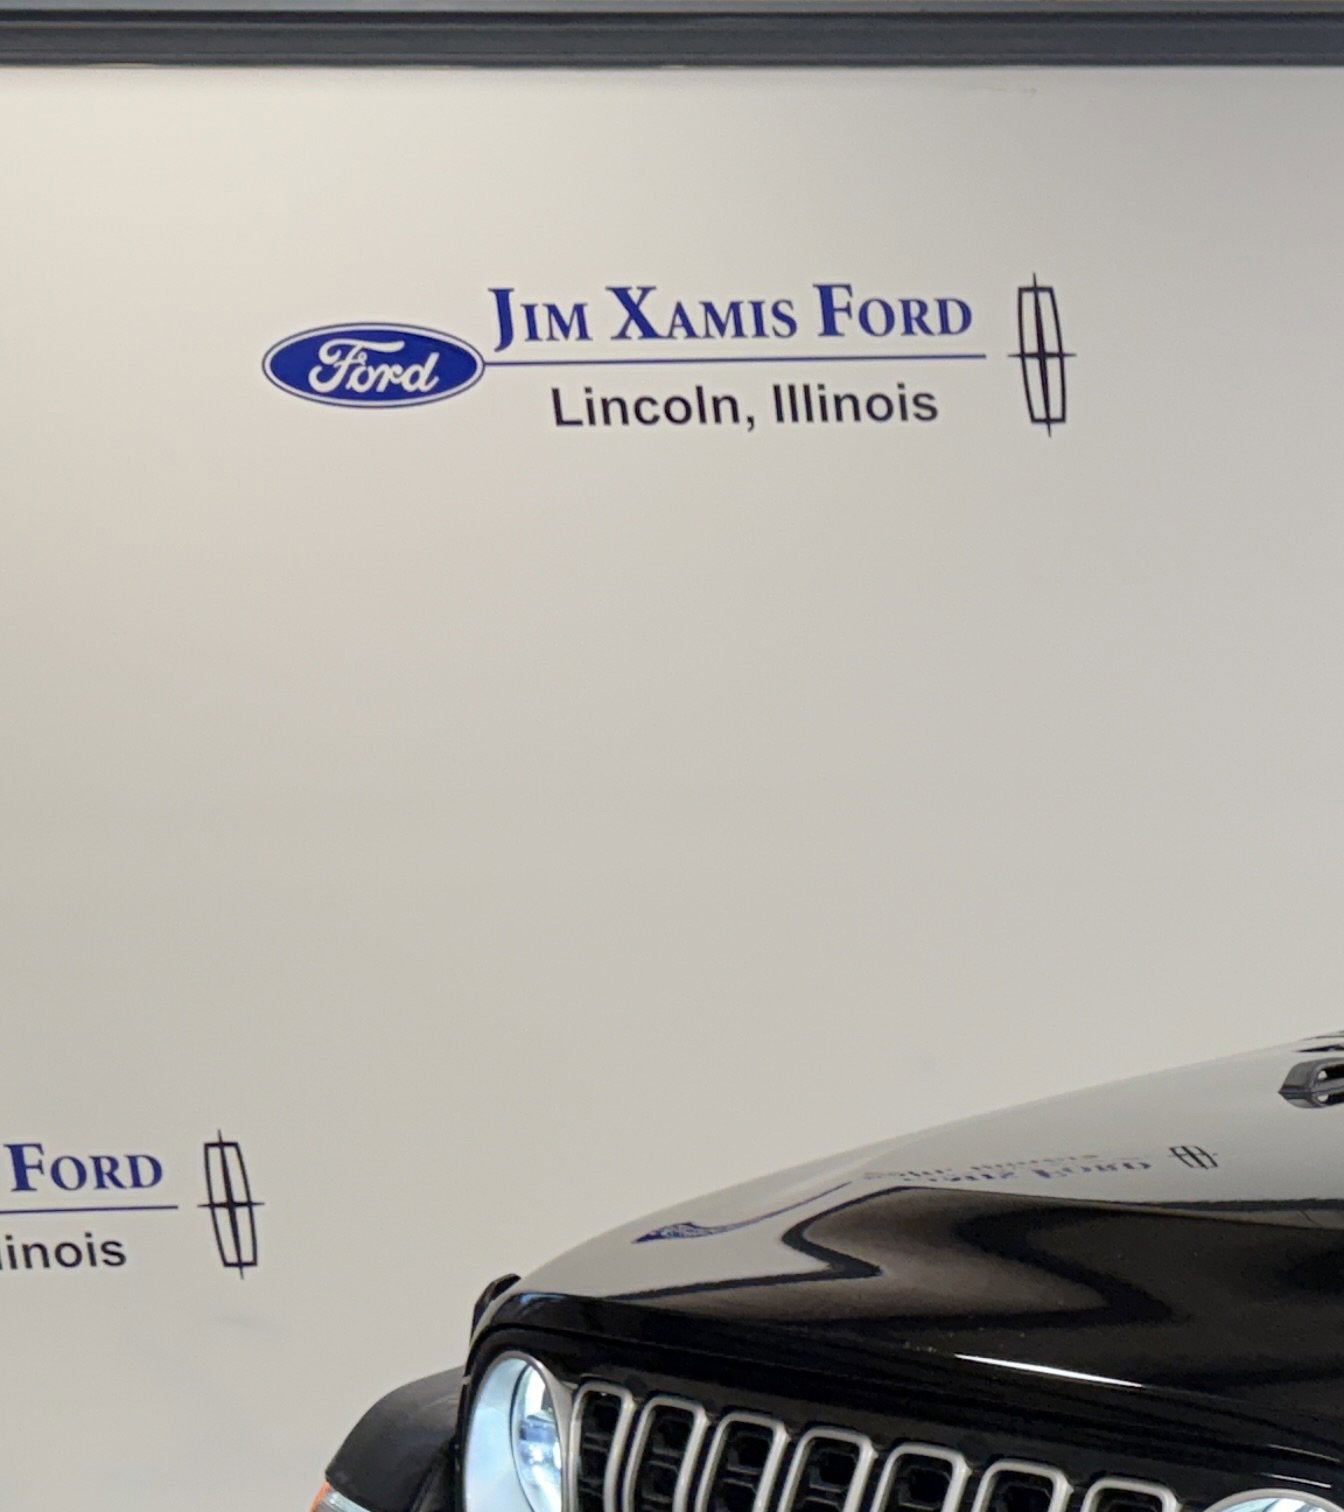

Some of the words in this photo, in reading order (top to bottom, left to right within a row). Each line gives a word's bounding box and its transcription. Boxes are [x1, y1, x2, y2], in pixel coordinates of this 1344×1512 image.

[308, 337, 441, 396] Ford
[550, 384, 756, 432] Lincoln,
[771, 381, 940, 424] Illinois
[0, 1231, 127, 1269] inois
